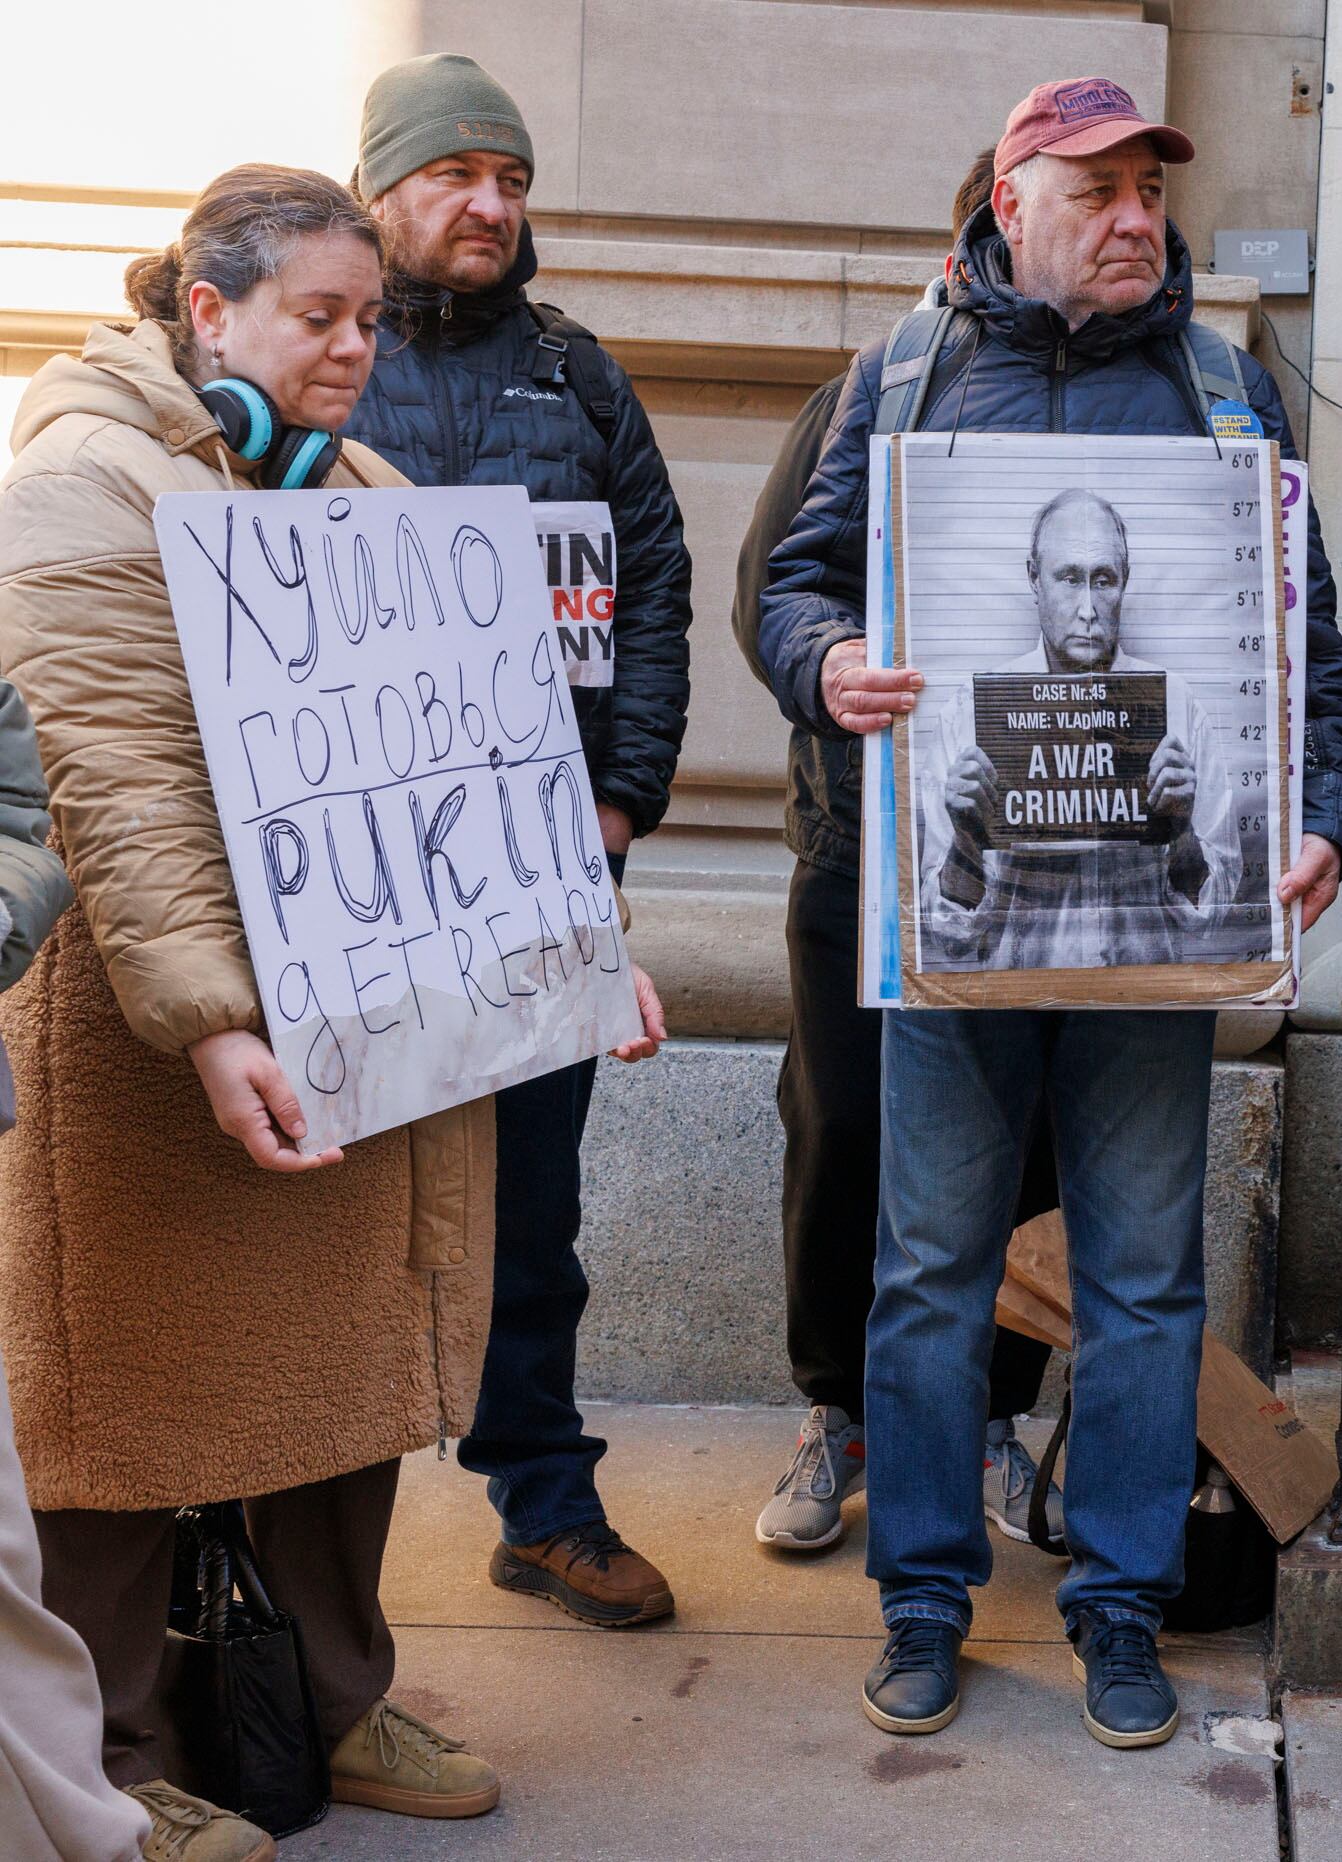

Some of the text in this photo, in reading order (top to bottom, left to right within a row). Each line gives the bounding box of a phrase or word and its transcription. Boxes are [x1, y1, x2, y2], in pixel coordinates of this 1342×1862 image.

[1213, 416, 1250, 424] #STAND
[1215, 425, 1240, 433] WITH
[537, 532, 613, 586] IN
[1032, 684, 1067, 701] CASE
[1007, 709, 1131, 730] NAME: VLADMIR P.
[1028, 742, 1115, 780] A WAR
[1005, 788, 1148, 825] CRIMINAL
